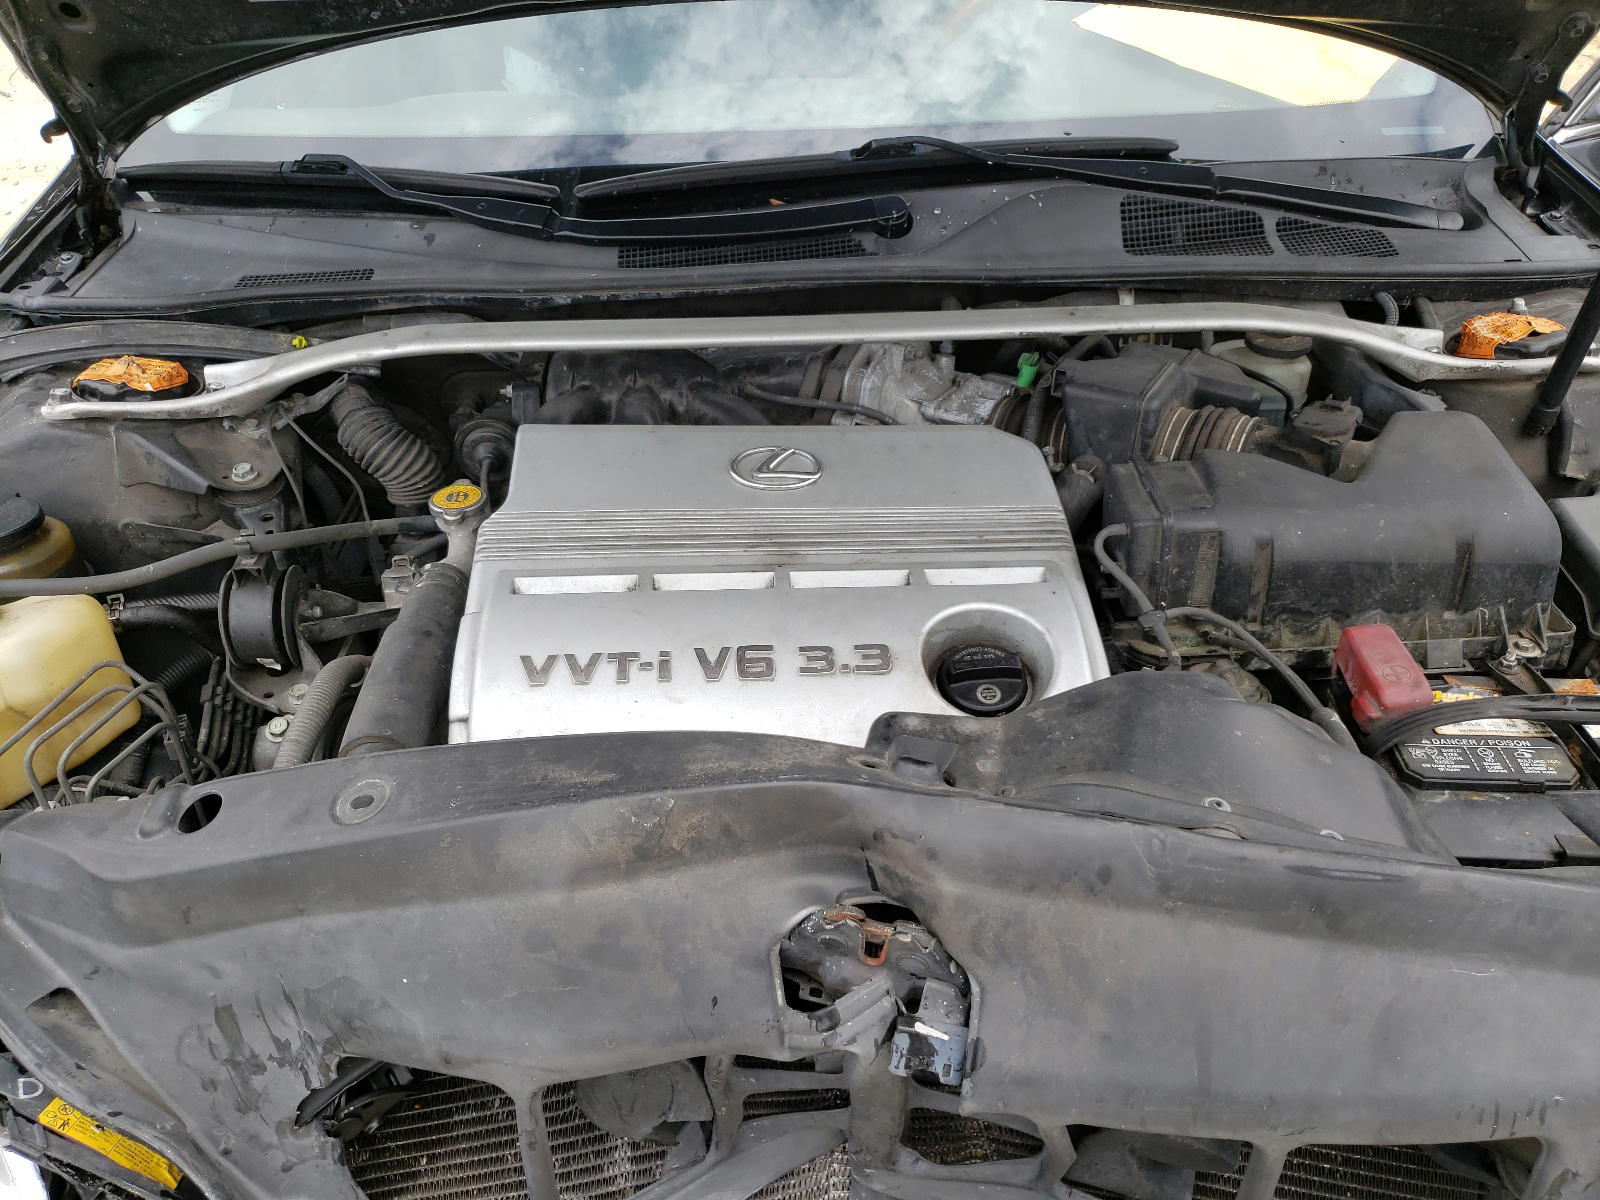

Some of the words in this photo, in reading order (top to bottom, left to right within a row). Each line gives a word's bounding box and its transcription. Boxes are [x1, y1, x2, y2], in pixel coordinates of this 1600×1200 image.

[519, 650, 674, 687] VVT-i
[693, 644, 776, 682] V6
[799, 643, 894, 676] 3.3
[1431, 738, 1478, 746] DANGER
[1487, 739, 1532, 747] POISON
[18, 1077, 44, 1100] D
